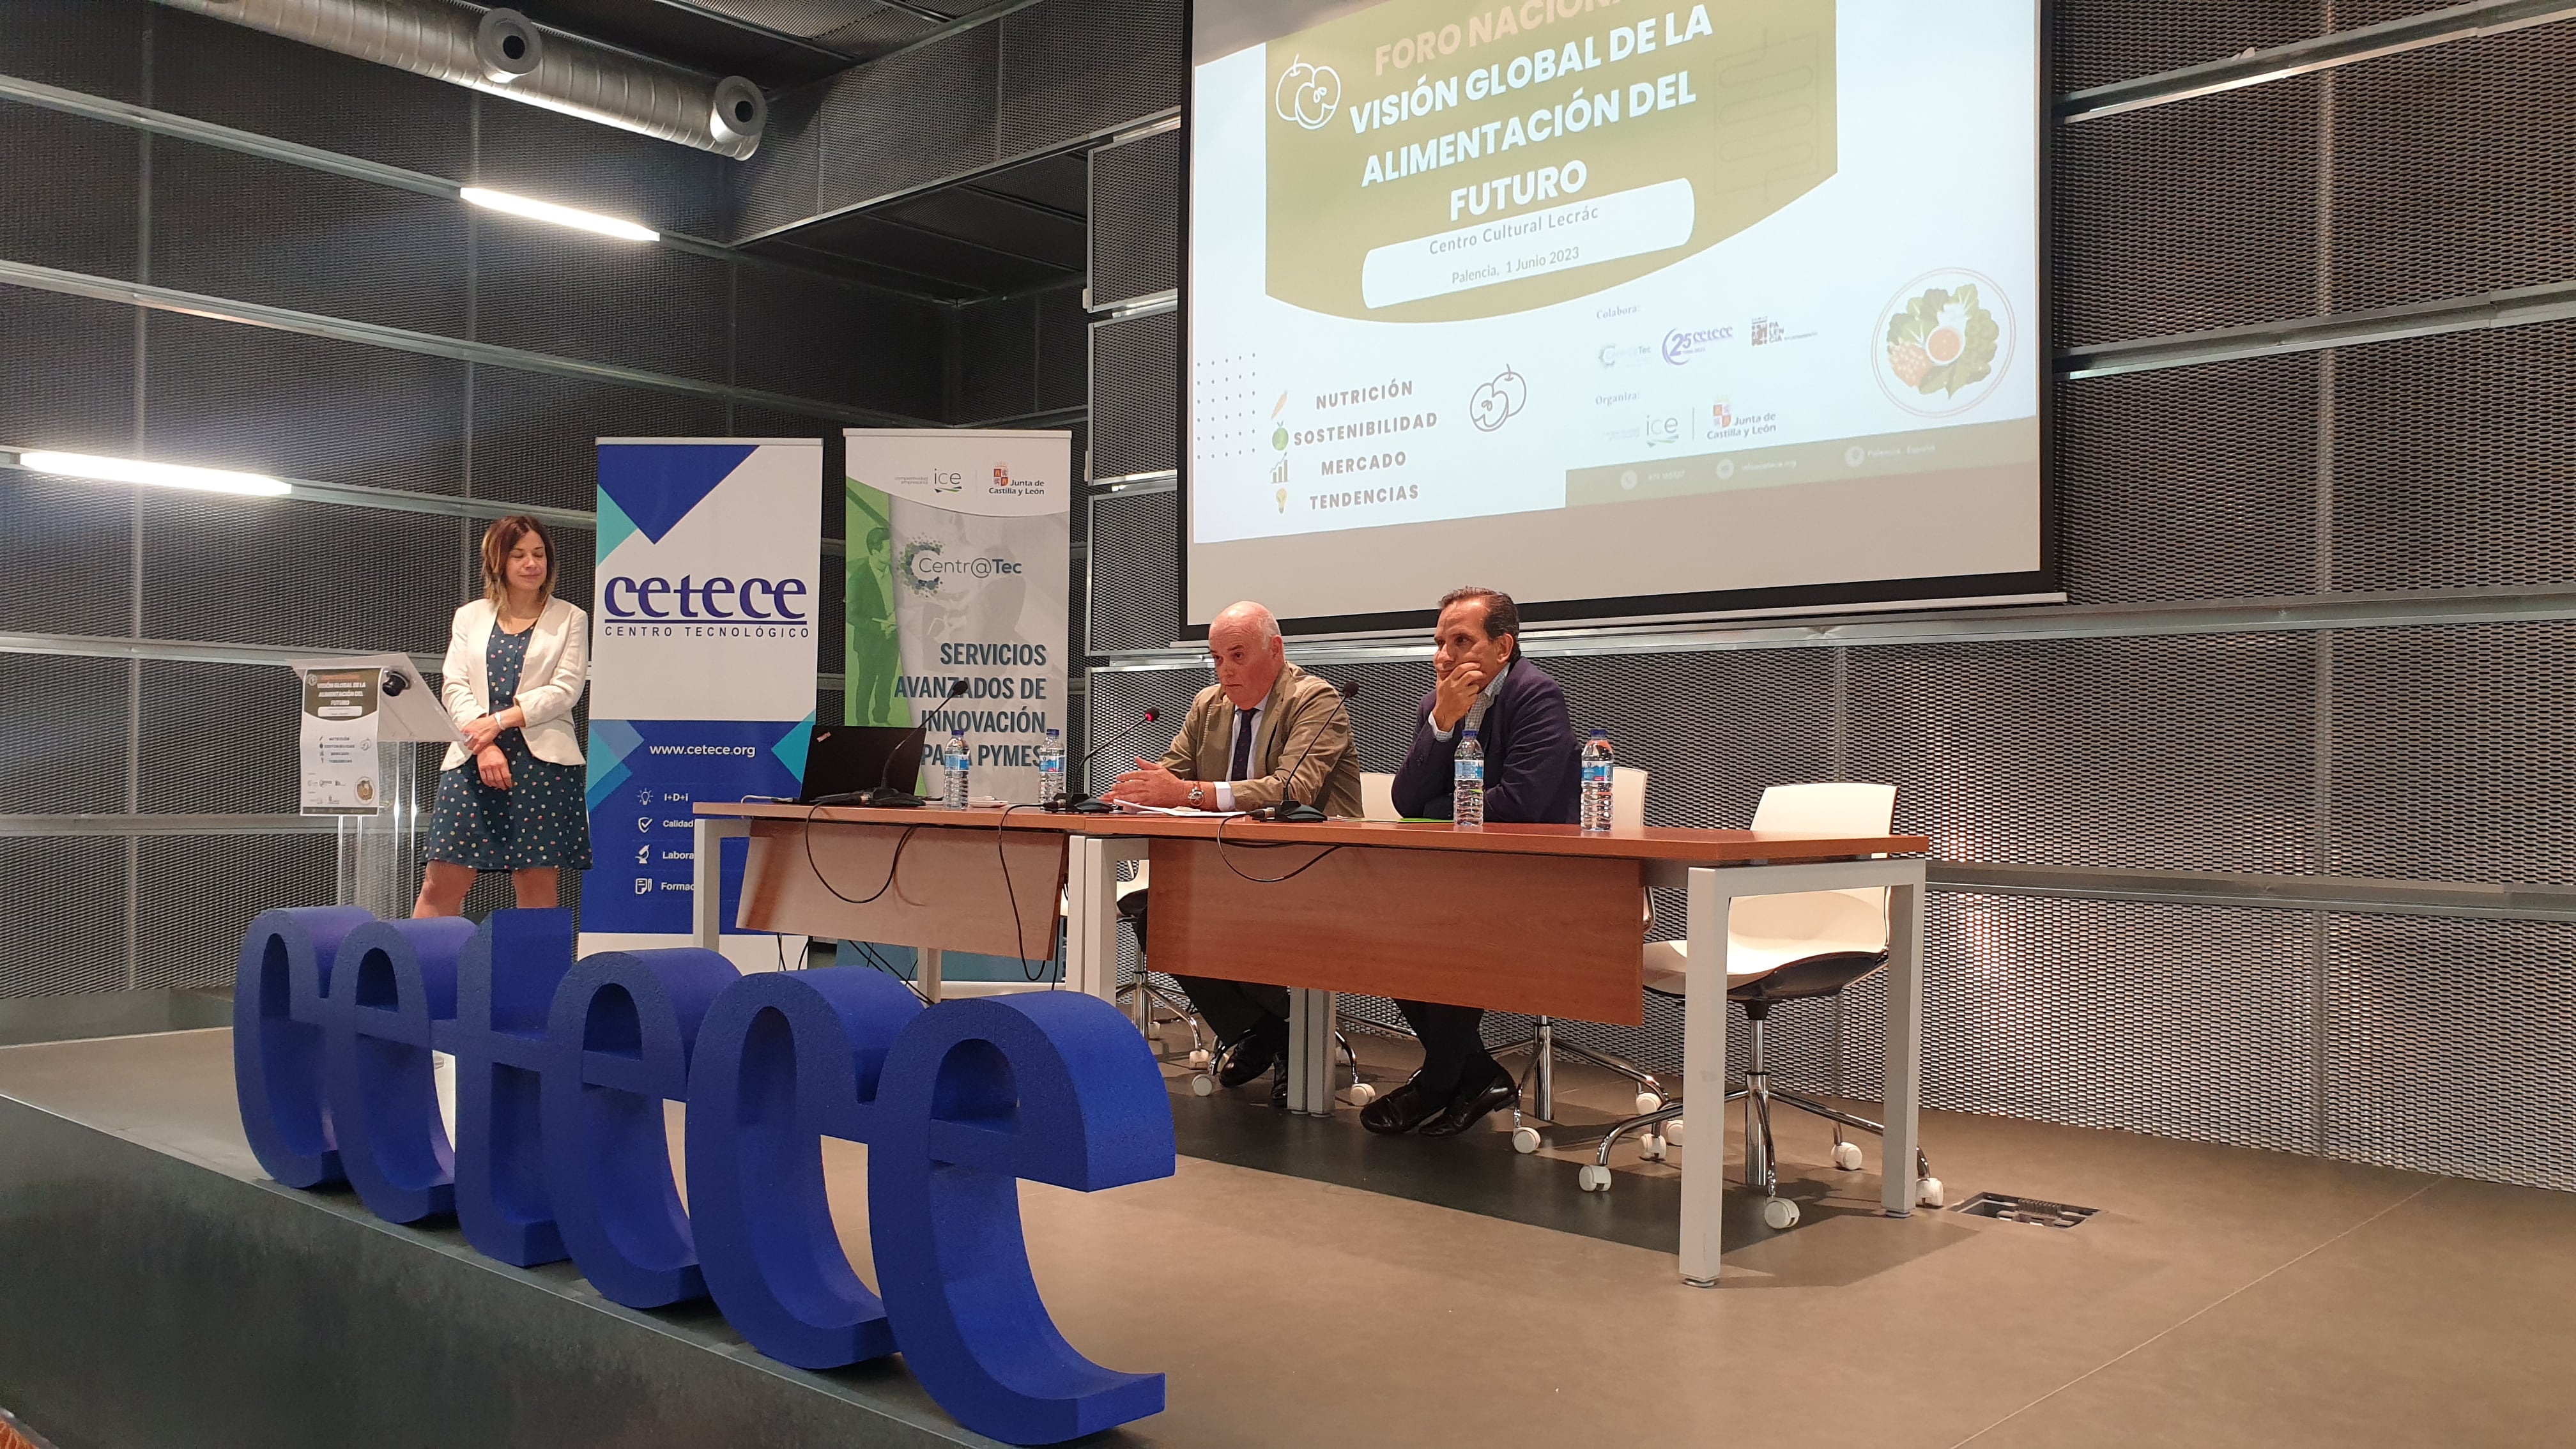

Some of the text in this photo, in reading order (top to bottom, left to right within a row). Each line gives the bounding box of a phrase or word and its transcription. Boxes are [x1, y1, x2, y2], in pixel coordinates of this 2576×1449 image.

[1375, 0, 1621, 76] FORO NACIO
[1349, 3, 1713, 134] VISIÓN GLOBAL DE LA
[1361, 70, 1696, 187] ALIMENTACIÓN DEL
[1450, 160, 1588, 221] FUTURO
[1429, 205, 1598, 255] Centro Cultural Lecrác
[1452, 246, 1579, 284] Palencia, 1 Junio 2023
[1315, 378, 1413, 410] NUTRICIÓN
[1294, 412, 1438, 446] SOSTENIBILIDAD
[1646, 415, 1678, 436] ice
[1734, 412, 1777, 426] Junta de
[1706, 424, 1777, 440] Castilla y León
[1321, 451, 1406, 476] MERCADO
[934, 468, 962, 485] ice
[1309, 484, 1420, 510] TENDENCIAS
[918, 558, 1022, 578] Centr@Tec
[604, 574, 807, 619] cetece
[604, 625, 809, 638] CENTRO TECNOLÓGICO
[940, 642, 1046, 666] SERVICIOS
[894, 676, 1046, 700] AVANZADOS DE
[922, 706, 1045, 733] INNOVACIÓN
[650, 744, 756, 758] www.cetece.org
[977, 744, 1043, 767] PYMES
[664, 793, 689, 802] I+D+i
[663, 820, 694, 828] Calidad
[234, 906, 1176, 1446] cetece
